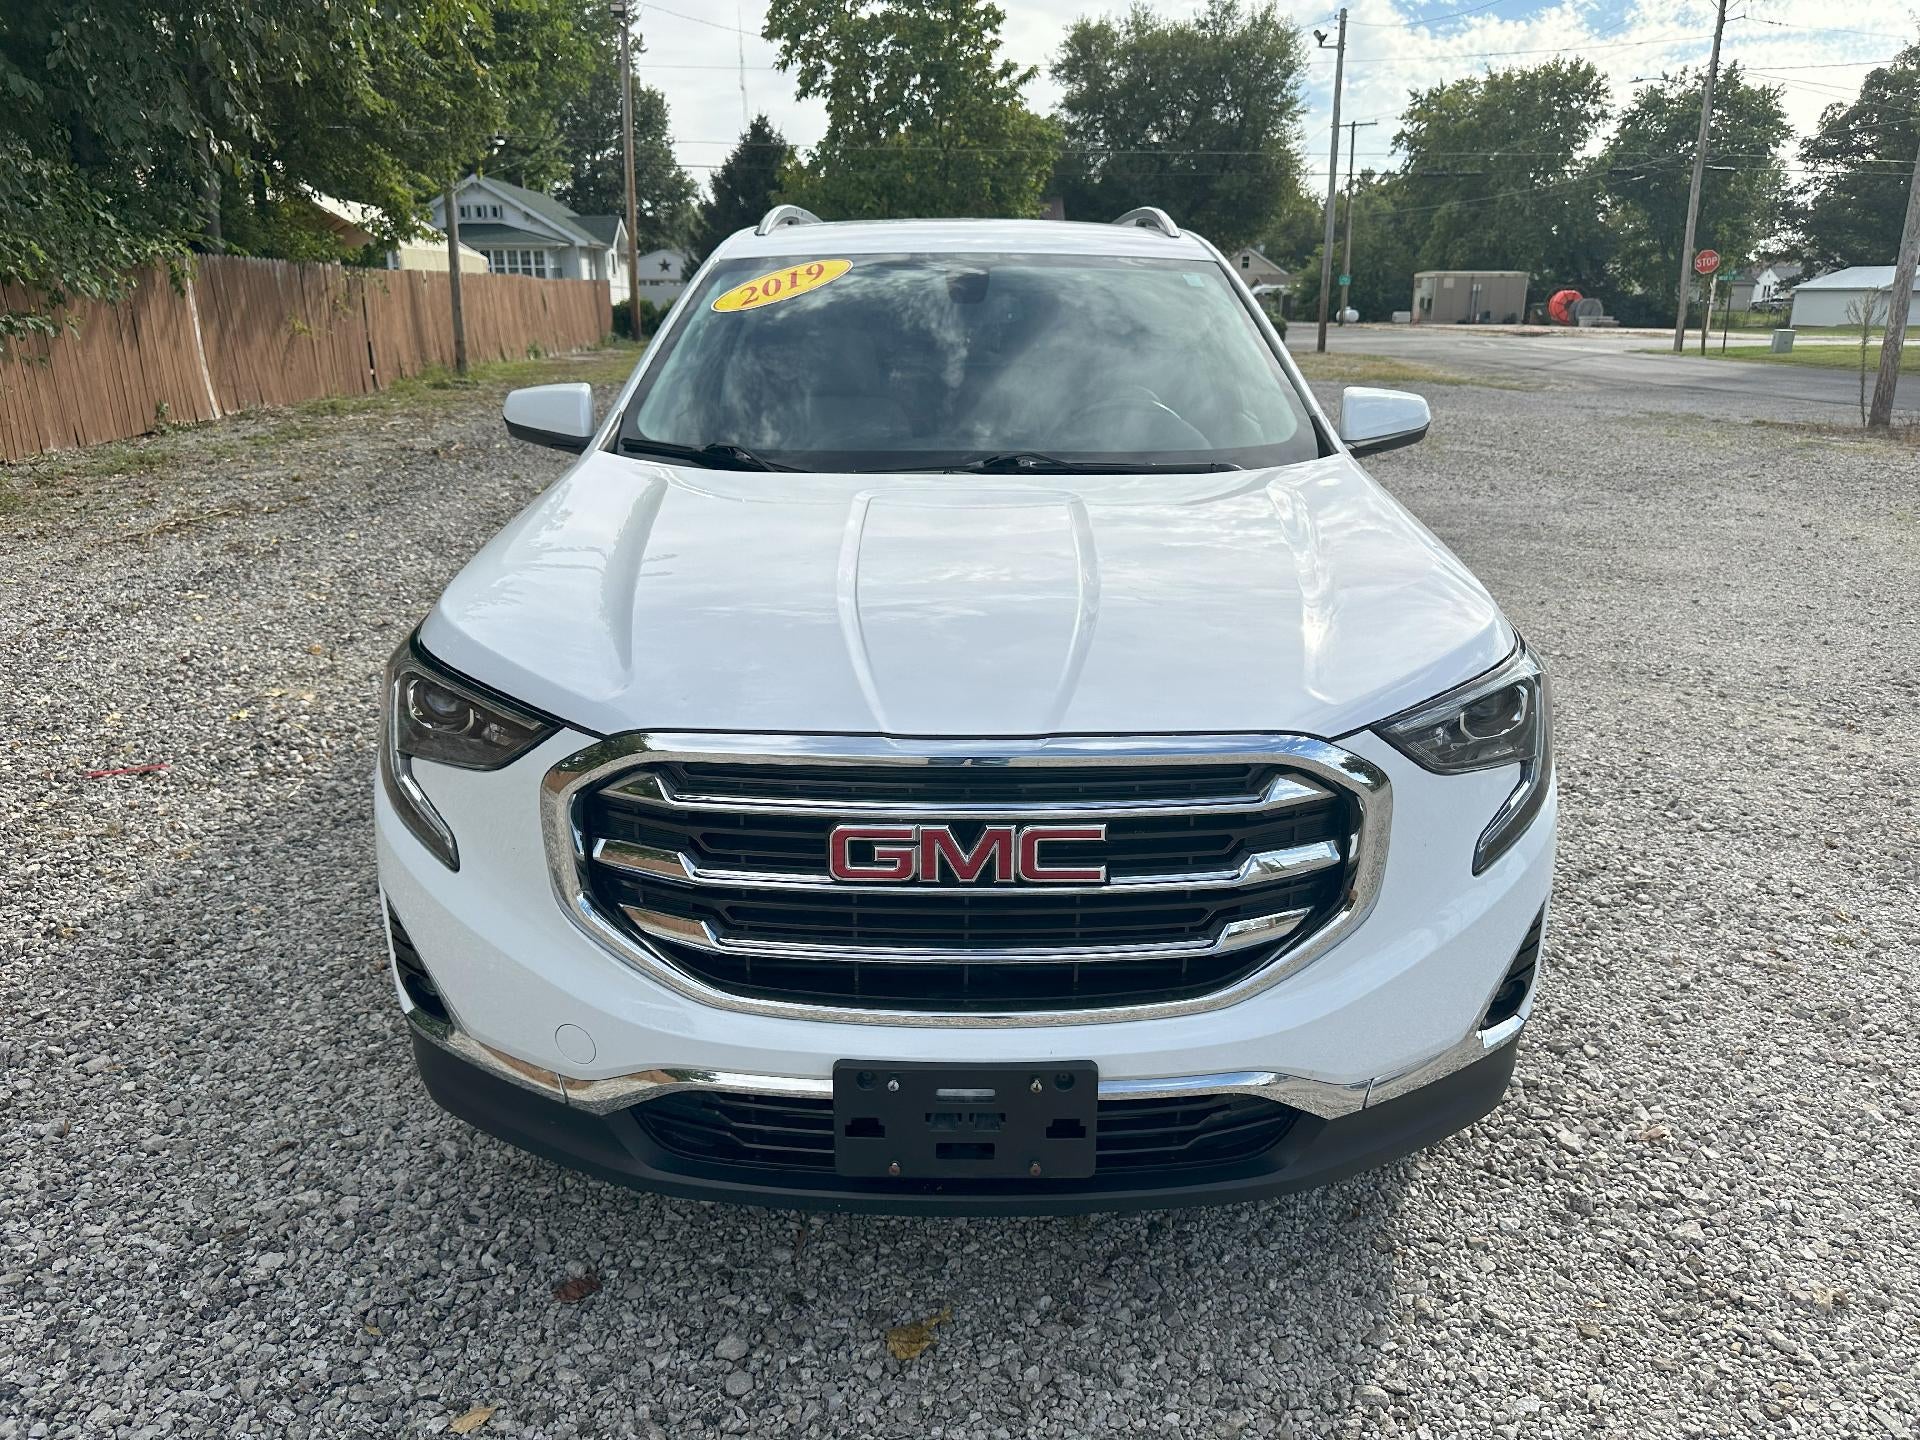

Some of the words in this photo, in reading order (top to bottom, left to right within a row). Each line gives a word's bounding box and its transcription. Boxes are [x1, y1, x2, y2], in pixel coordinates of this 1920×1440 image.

[1696, 256, 1718, 267] STOP
[740, 263, 825, 306] 2019
[829, 824, 1107, 883] GMC
